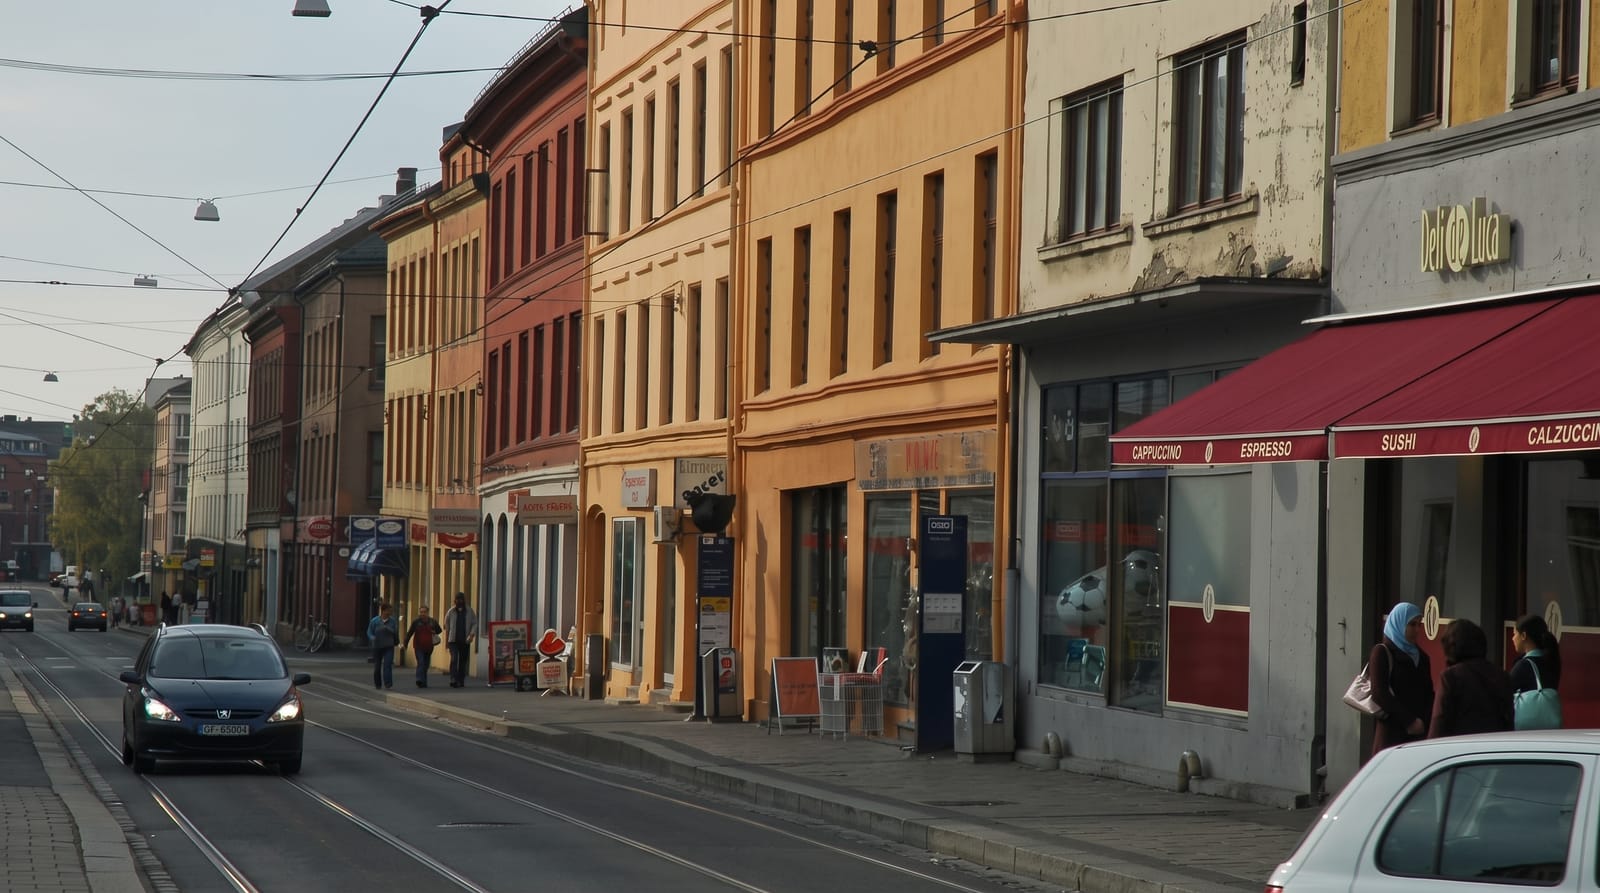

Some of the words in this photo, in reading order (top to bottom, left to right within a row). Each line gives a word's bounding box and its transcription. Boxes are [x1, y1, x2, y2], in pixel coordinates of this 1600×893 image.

[1421, 205, 1444, 272] Deli
[1471, 197, 1499, 264] Luca
[1132, 445, 1182, 460] CAPPUCCINO
[1240, 441, 1292, 458] ESPRESSO
[1381, 433, 1417, 451] SUSHI
